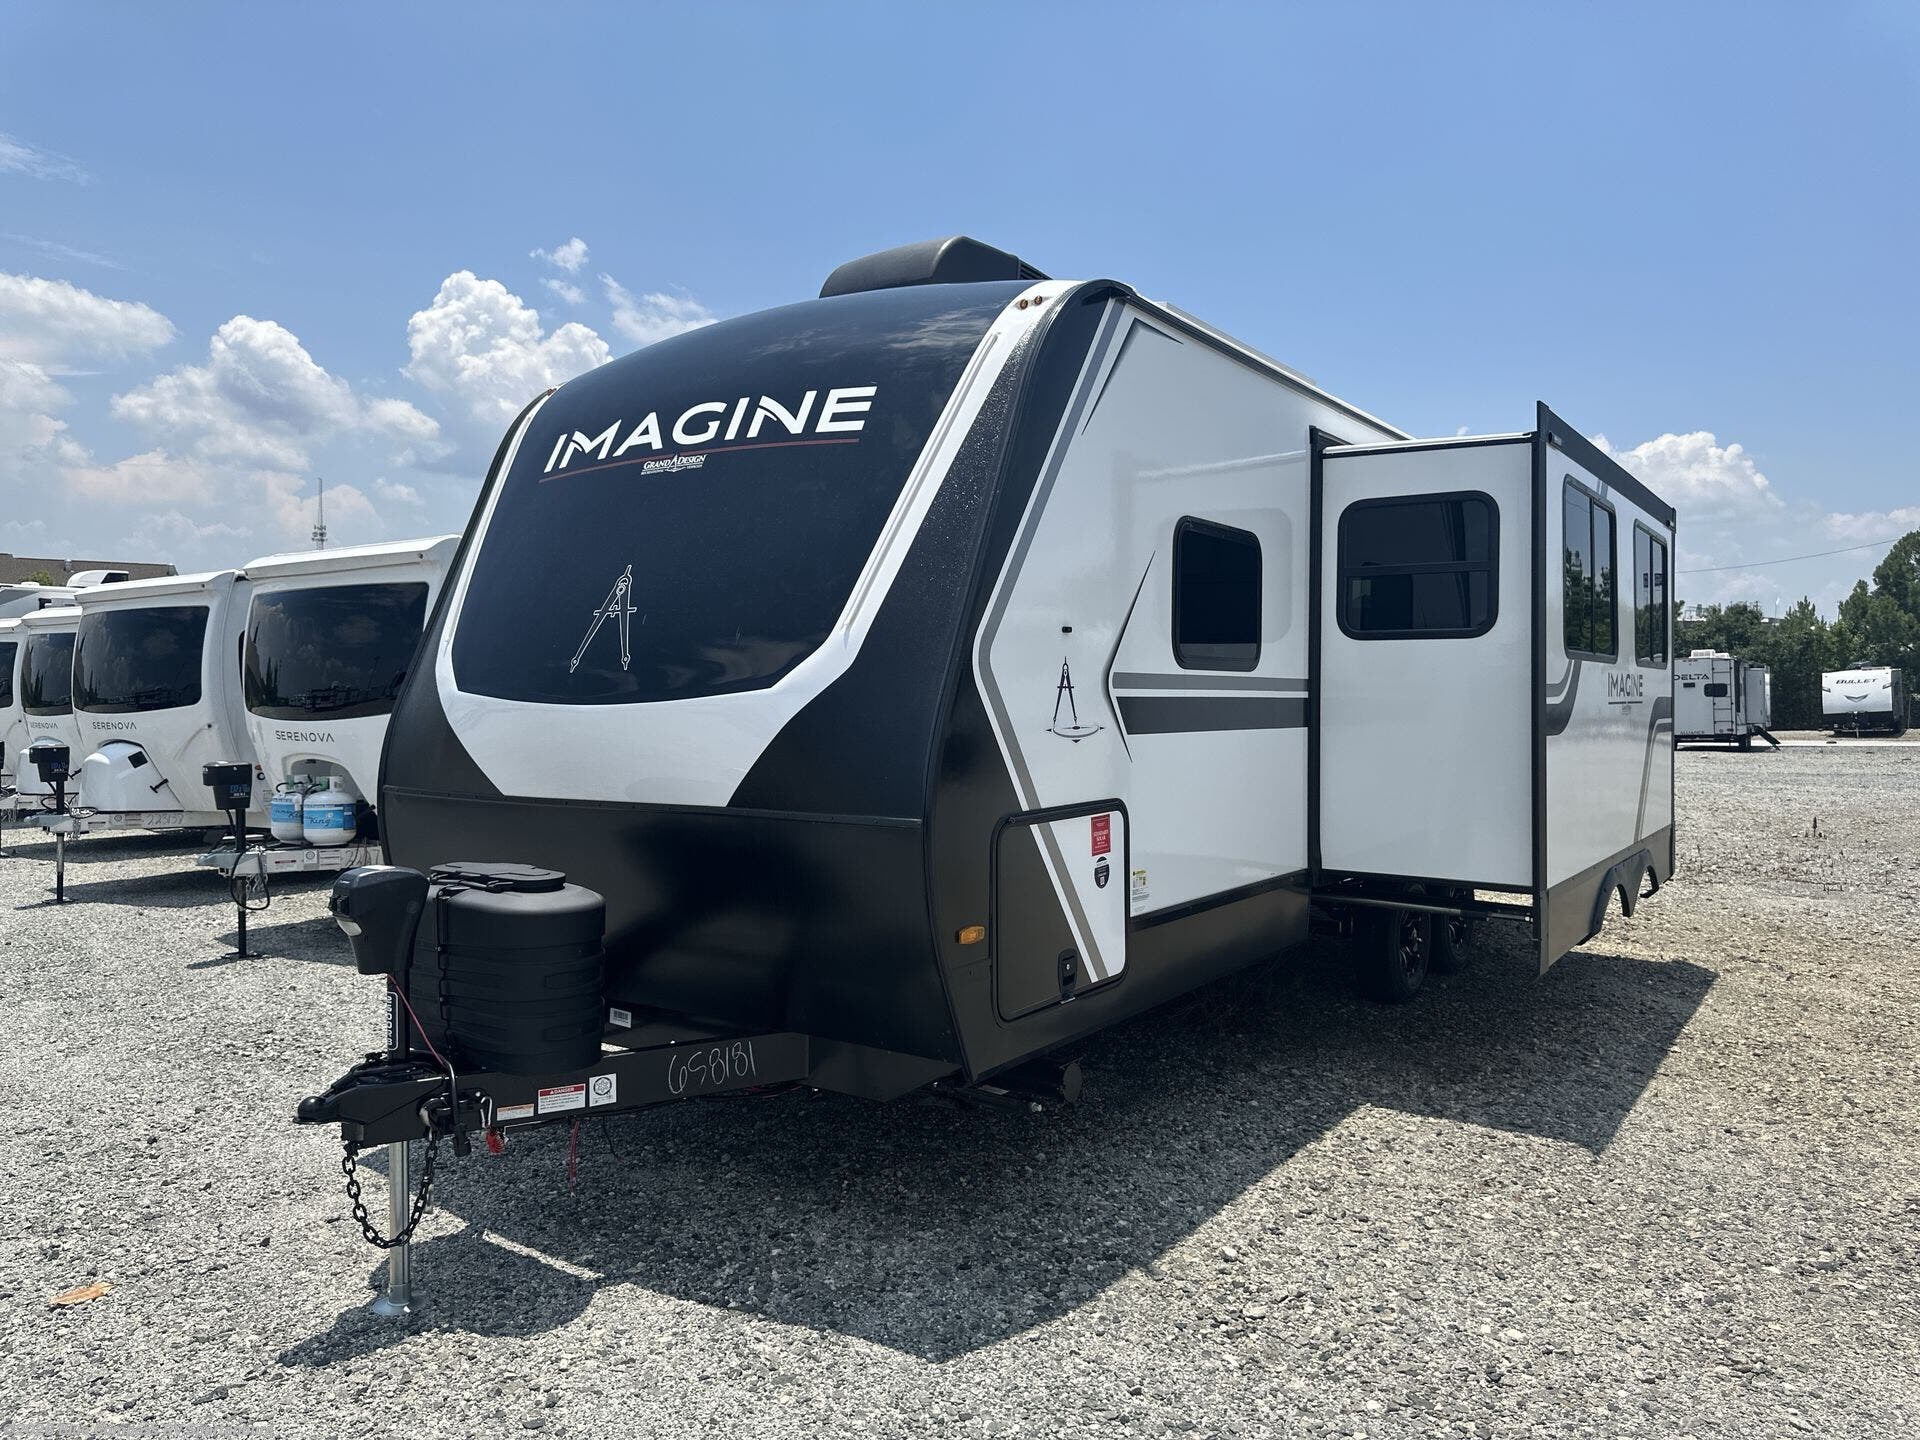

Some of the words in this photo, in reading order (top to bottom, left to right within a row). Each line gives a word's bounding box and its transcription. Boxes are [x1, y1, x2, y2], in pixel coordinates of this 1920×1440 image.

[543, 386, 878, 474] IMAGINE
[643, 459, 672, 471] GRAND
[676, 454, 708, 465] DESIGN
[1673, 673, 1710, 681] DELTA
[1607, 672, 1643, 698] IMAGINE
[30, 721, 59, 730] SERENOVA
[92, 721, 137, 731] SERENOVA
[275, 729, 335, 743] SERENOVA
[668, 1040, 756, 1094] 658181
[553, 1086, 575, 1095] DANGER
